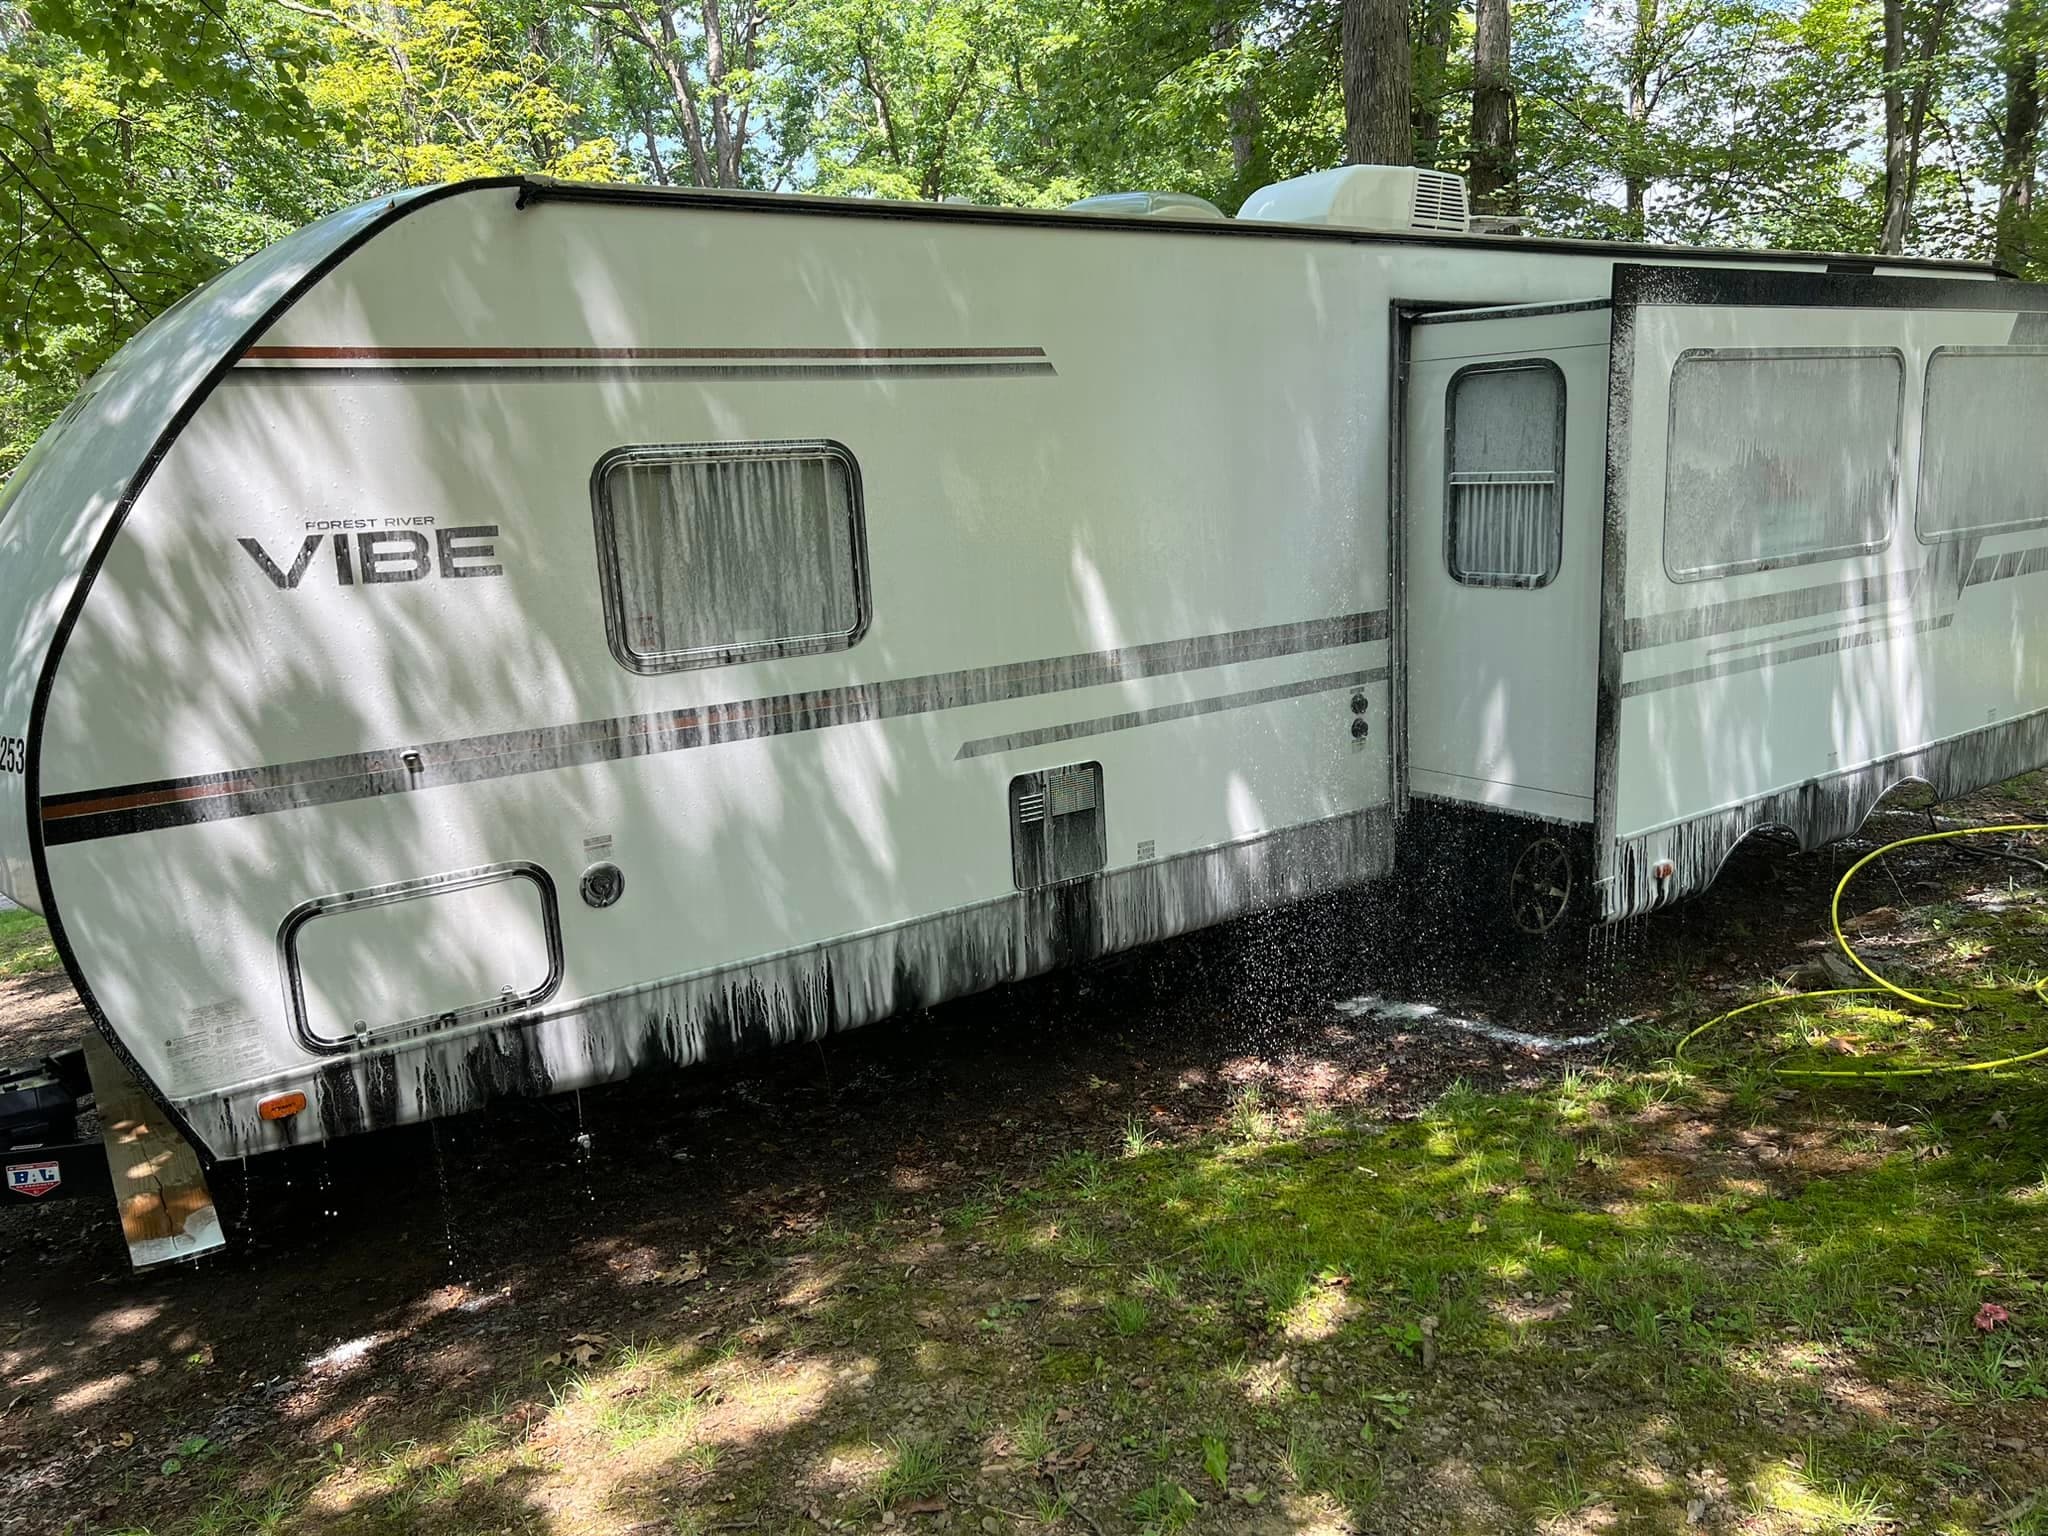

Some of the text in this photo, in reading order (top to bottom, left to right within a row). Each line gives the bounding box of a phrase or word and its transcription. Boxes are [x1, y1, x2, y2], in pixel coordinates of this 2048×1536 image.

[305, 515, 436, 531] FOREST RIVER
[236, 525, 504, 590] VIBE
